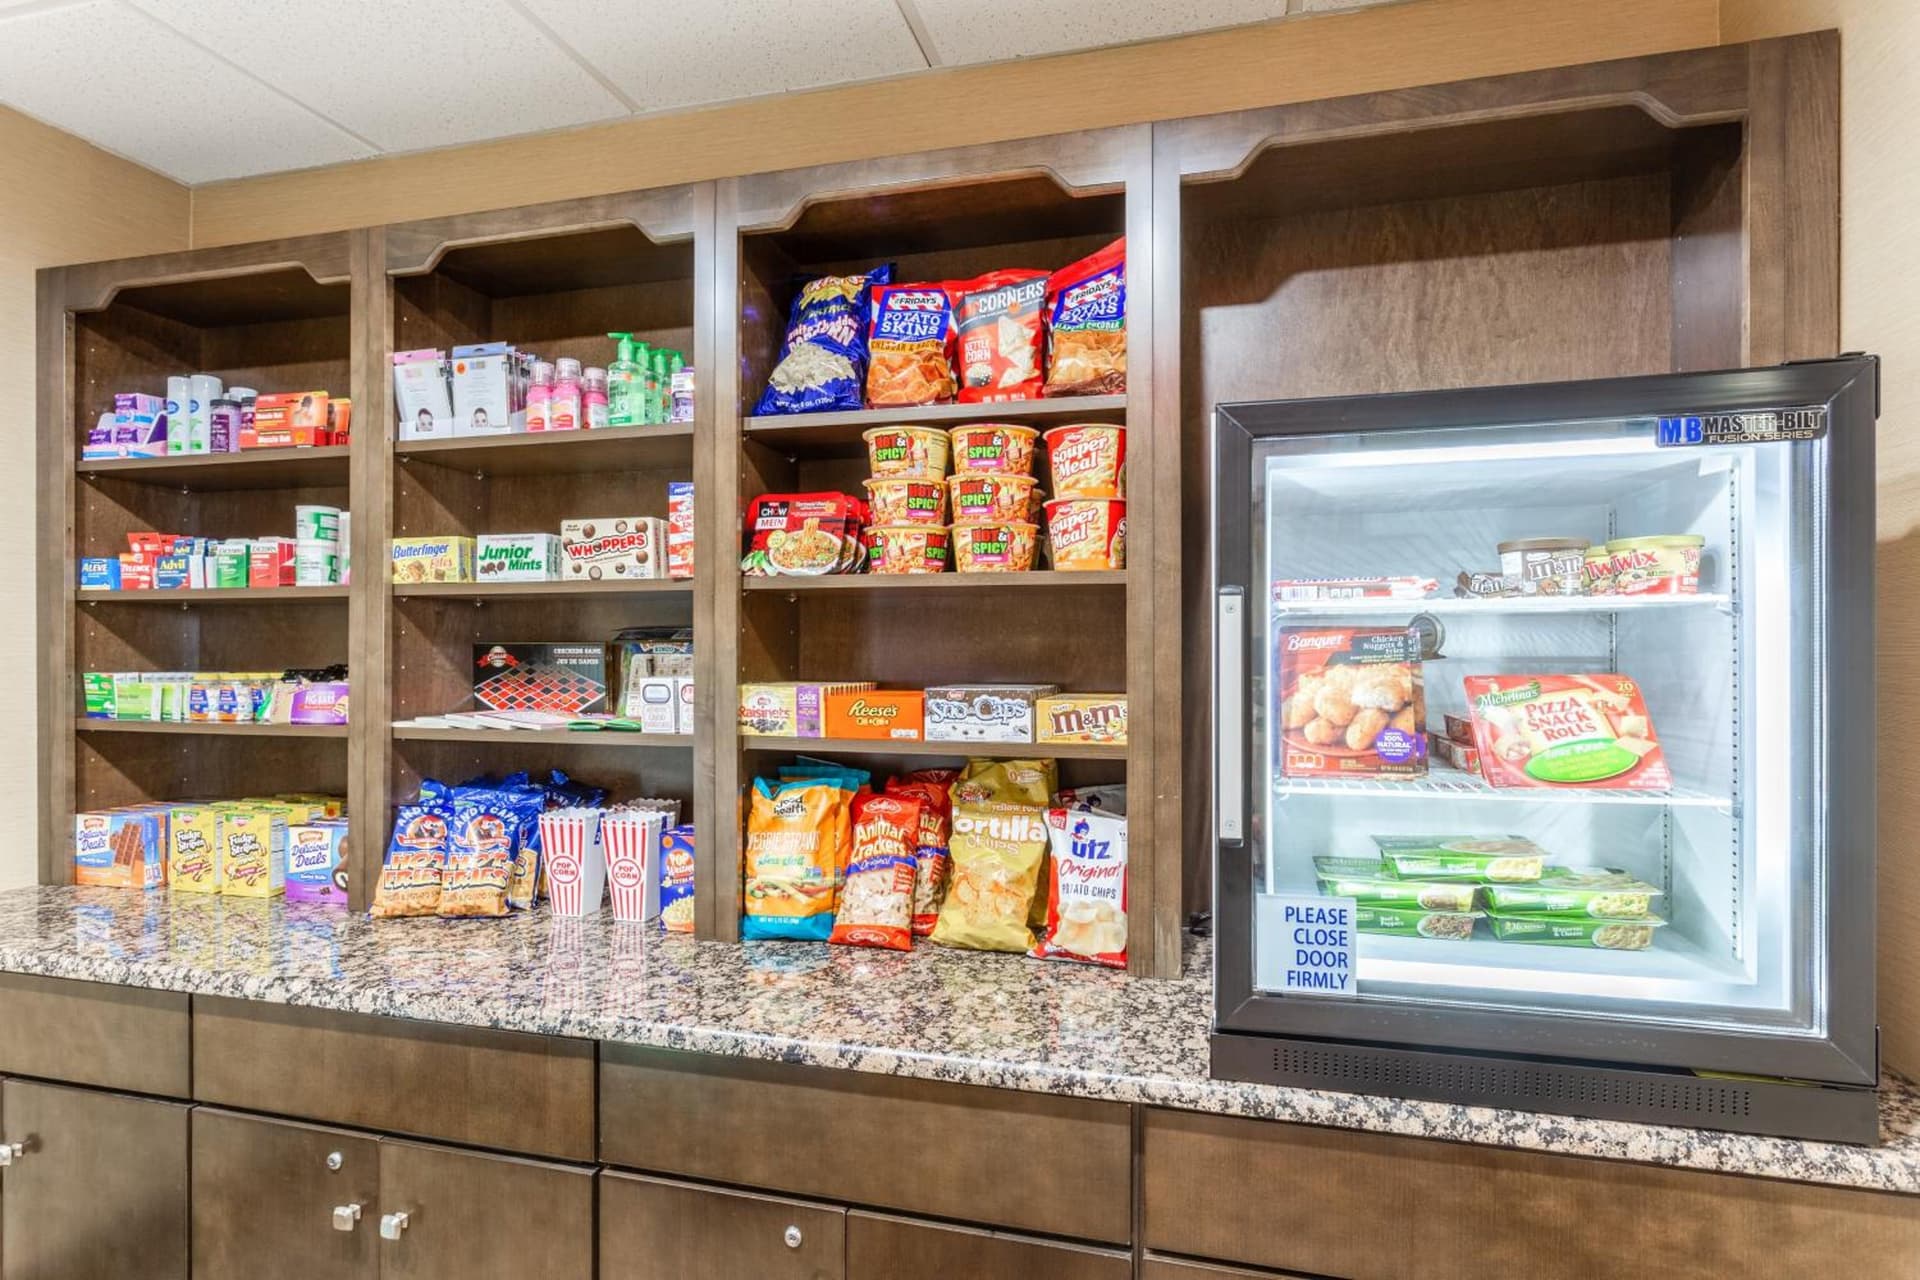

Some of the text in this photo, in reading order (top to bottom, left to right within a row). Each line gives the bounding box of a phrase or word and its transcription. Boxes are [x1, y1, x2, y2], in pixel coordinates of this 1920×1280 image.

[884, 312, 941, 326] POTATO
[880, 321, 939, 336] SKINS
[966, 350, 990, 363] CORN
[1703, 410, 1822, 434] MASTER-BILT
[875, 433, 898, 448] HOT
[967, 432, 993, 447] HOT
[1709, 429, 1814, 443] FUSION SERIES
[877, 447, 906, 460] SPICY
[968, 446, 1002, 459] SPICY
[1052, 436, 1108, 466] Souper
[1057, 452, 1098, 481] Meal
[908, 484, 932, 498] HOT
[960, 481, 985, 494] HOT
[961, 494, 992, 506] SPICY
[761, 508, 788, 516] CHOW
[760, 519, 784, 527] MEIN
[972, 529, 1000, 542] HOT
[393, 543, 449, 560] Butterfinger
[478, 544, 533, 561] Junior
[569, 533, 645, 557] WHOPPERS
[972, 541, 1008, 555] SPICY
[160, 559, 186, 570] Advil
[507, 559, 543, 571] Mints
[1287, 634, 1345, 650] Banquet
[1615, 682, 1634, 693] 20
[1477, 688, 1540, 710] Michelina's
[1524, 696, 1582, 717] PIZZA
[848, 699, 898, 718] Reese's
[1527, 708, 1592, 732] SNACK
[1542, 721, 1598, 742] ROLLS
[774, 803, 808, 815] health
[853, 812, 907, 842] Animal
[850, 835, 909, 863] Crackers
[295, 851, 328, 868] Deals
[615, 872, 638, 880] CORN
[1059, 858, 1123, 884] Original
[1091, 885, 1117, 900] CHIPS
[1285, 906, 1348, 926] PLEASE
[1293, 927, 1348, 947] CLOSE
[1296, 949, 1348, 969] DOOR
[1287, 970, 1348, 990] FIRMLY
